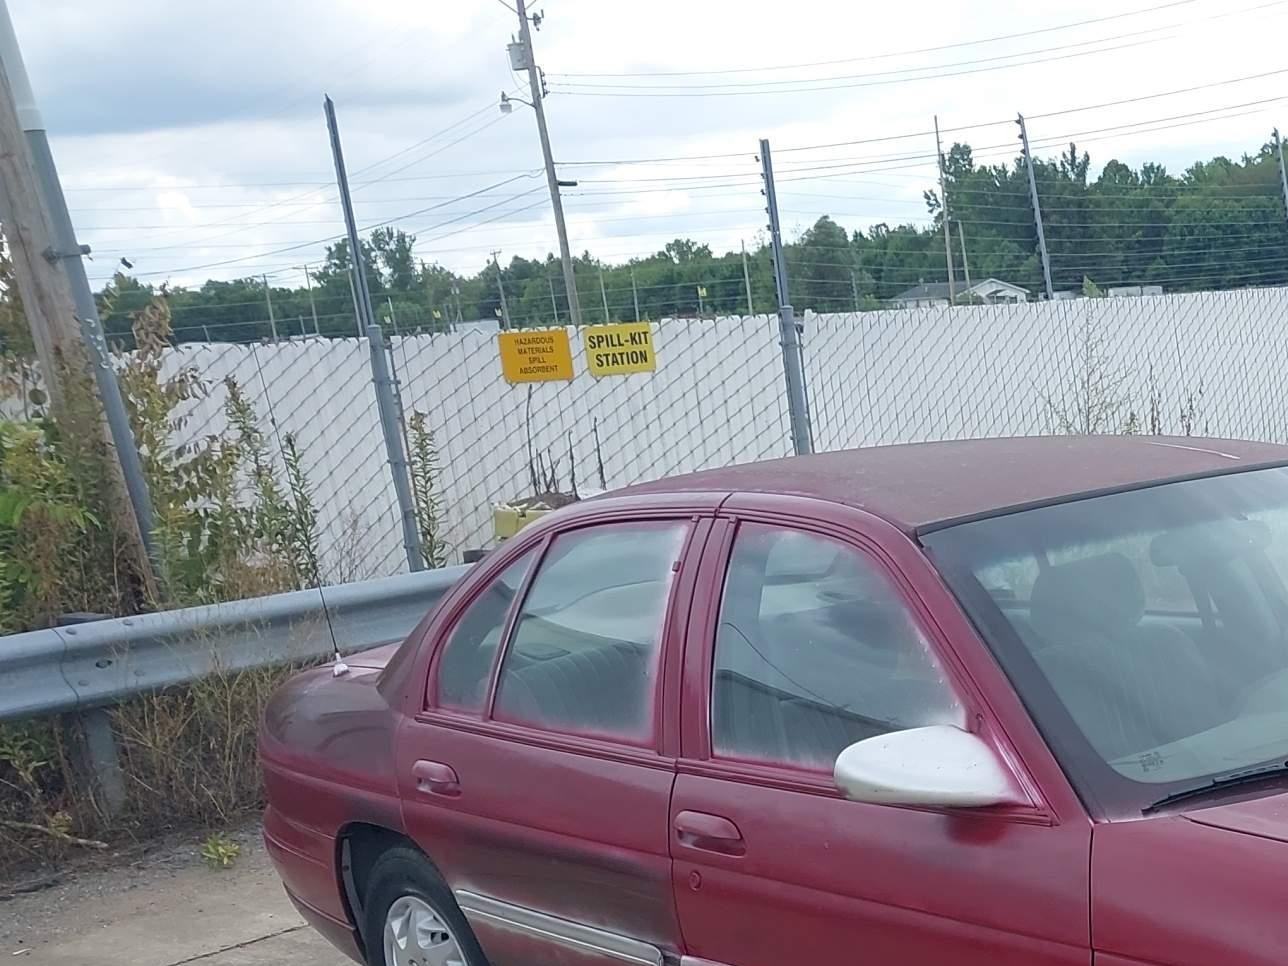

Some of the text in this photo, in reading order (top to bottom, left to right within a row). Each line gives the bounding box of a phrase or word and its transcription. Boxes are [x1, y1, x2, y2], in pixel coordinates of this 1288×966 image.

[514, 336, 554, 345] HAZARDOUS
[588, 331, 649, 350] SPILL-KIT
[517, 346, 554, 355] MATERIALS
[528, 356, 547, 364] SPILL
[596, 350, 648, 368] STATION
[519, 365, 558, 375] ABSORBENT
